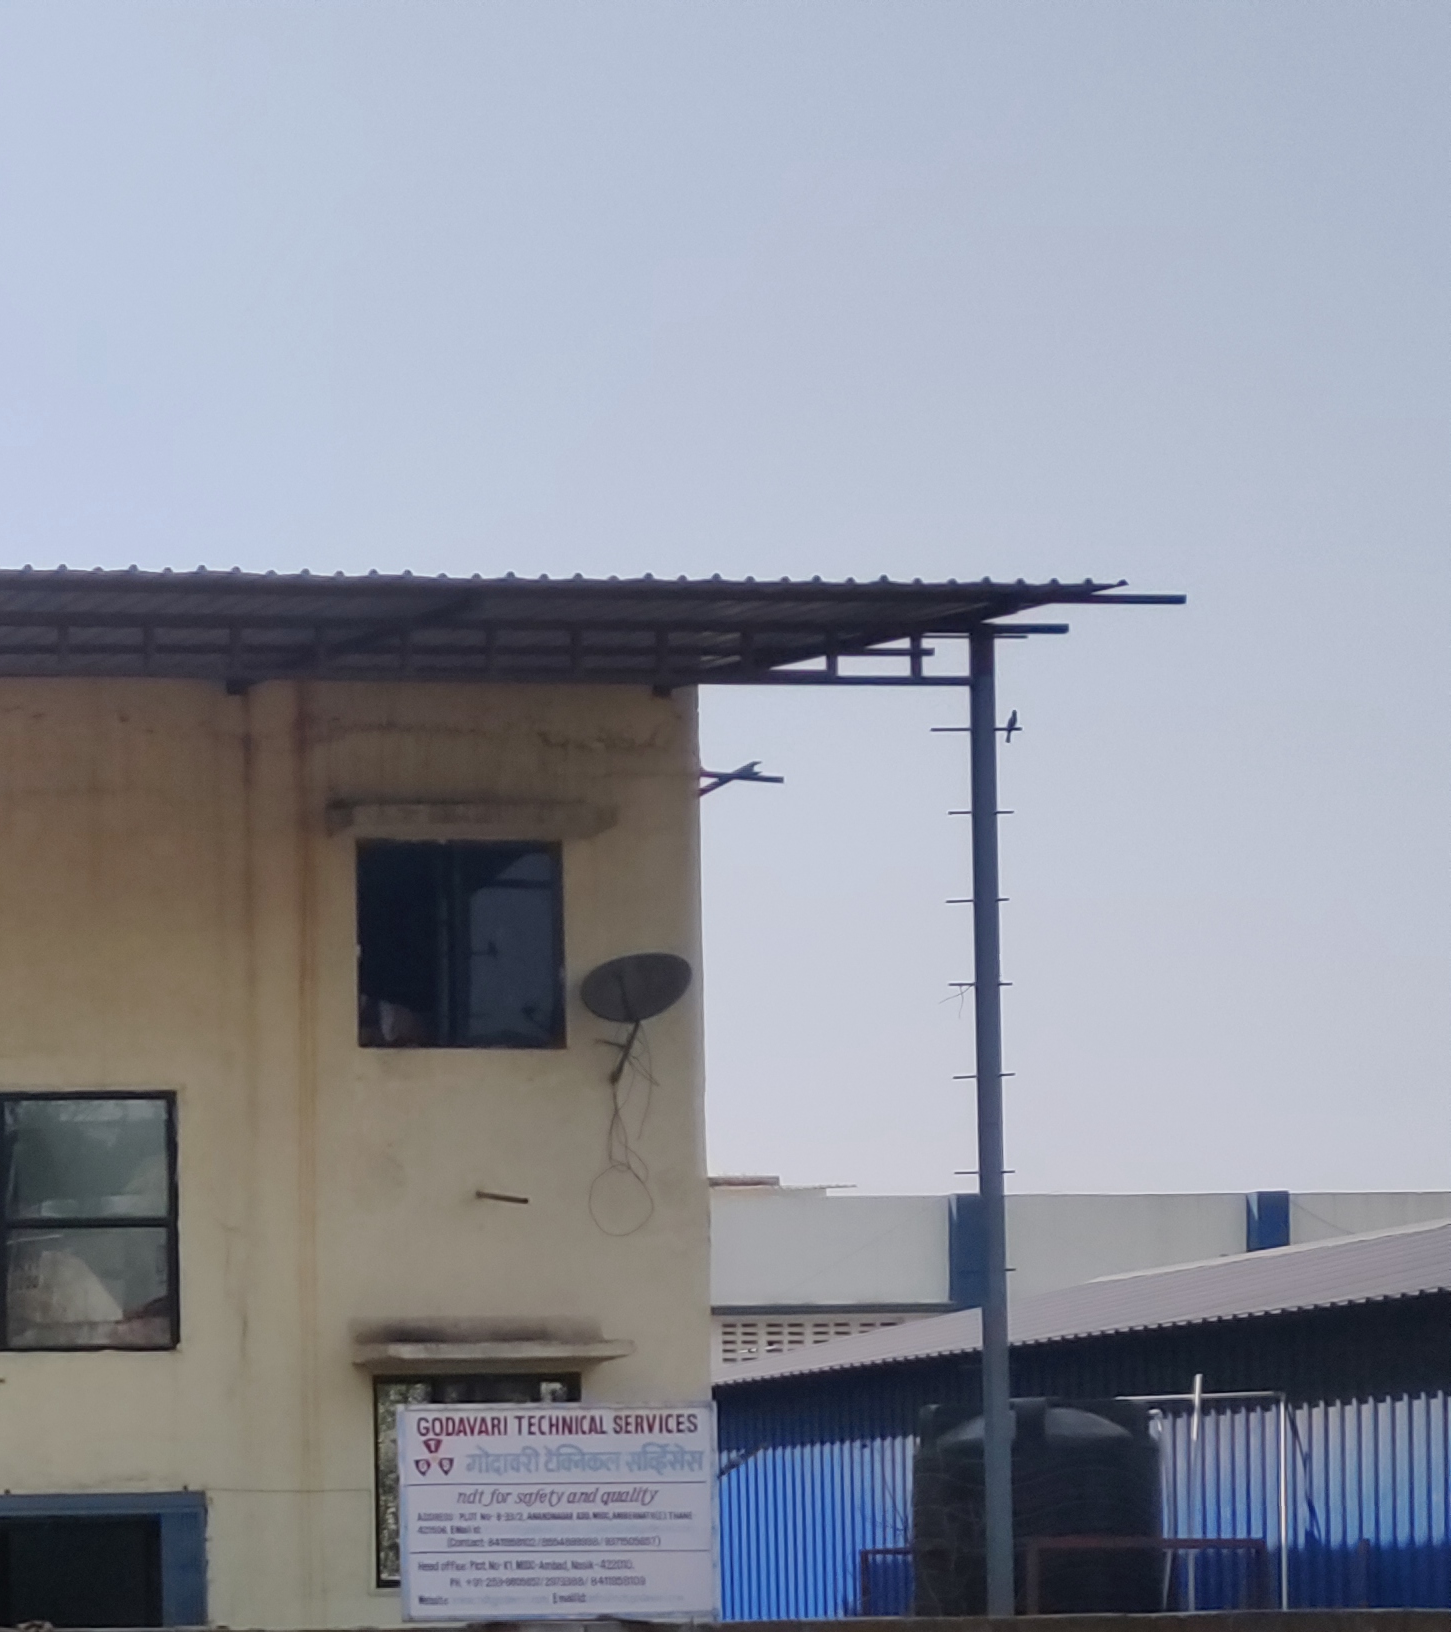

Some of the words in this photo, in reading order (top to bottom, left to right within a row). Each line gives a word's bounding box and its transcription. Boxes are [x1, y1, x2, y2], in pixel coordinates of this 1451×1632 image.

[417, 1416, 508, 1437] GODAVARI
[514, 1414, 607, 1436] TECHNICAL
[613, 1413, 698, 1435] SERVICES
[466, 1445, 541, 1476] गोदावरी
[457, 1489, 485, 1505] ndt
[483, 1489, 513, 1507] for
[514, 1488, 565, 1507] safety
[567, 1487, 599, 1504] and
[600, 1486, 659, 1507] quality
